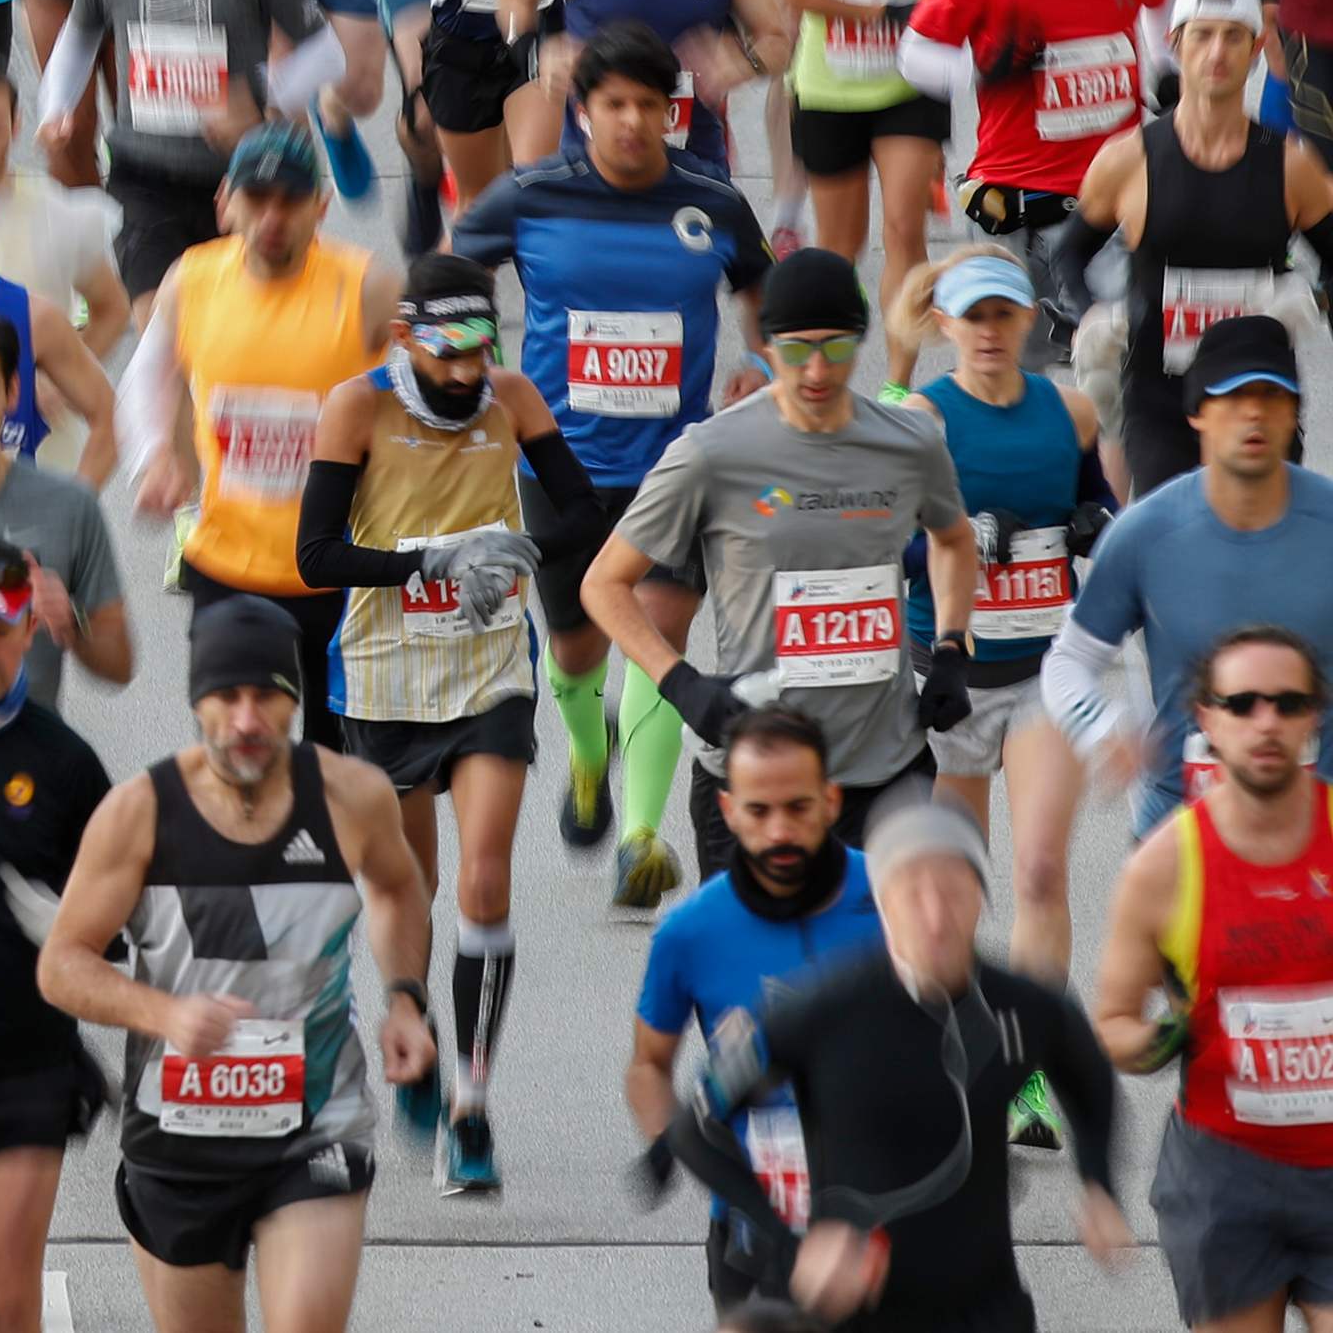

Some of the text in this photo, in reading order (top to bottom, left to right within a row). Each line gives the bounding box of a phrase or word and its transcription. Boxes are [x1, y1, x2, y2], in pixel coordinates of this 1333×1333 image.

[583, 347, 670, 382] A 9037
[406, 571, 430, 604] A
[976, 574, 993, 603] A
[783, 605, 895, 647] A 12179
[179, 1062, 285, 1098] A 6038
[1237, 1045, 1258, 1084] A
